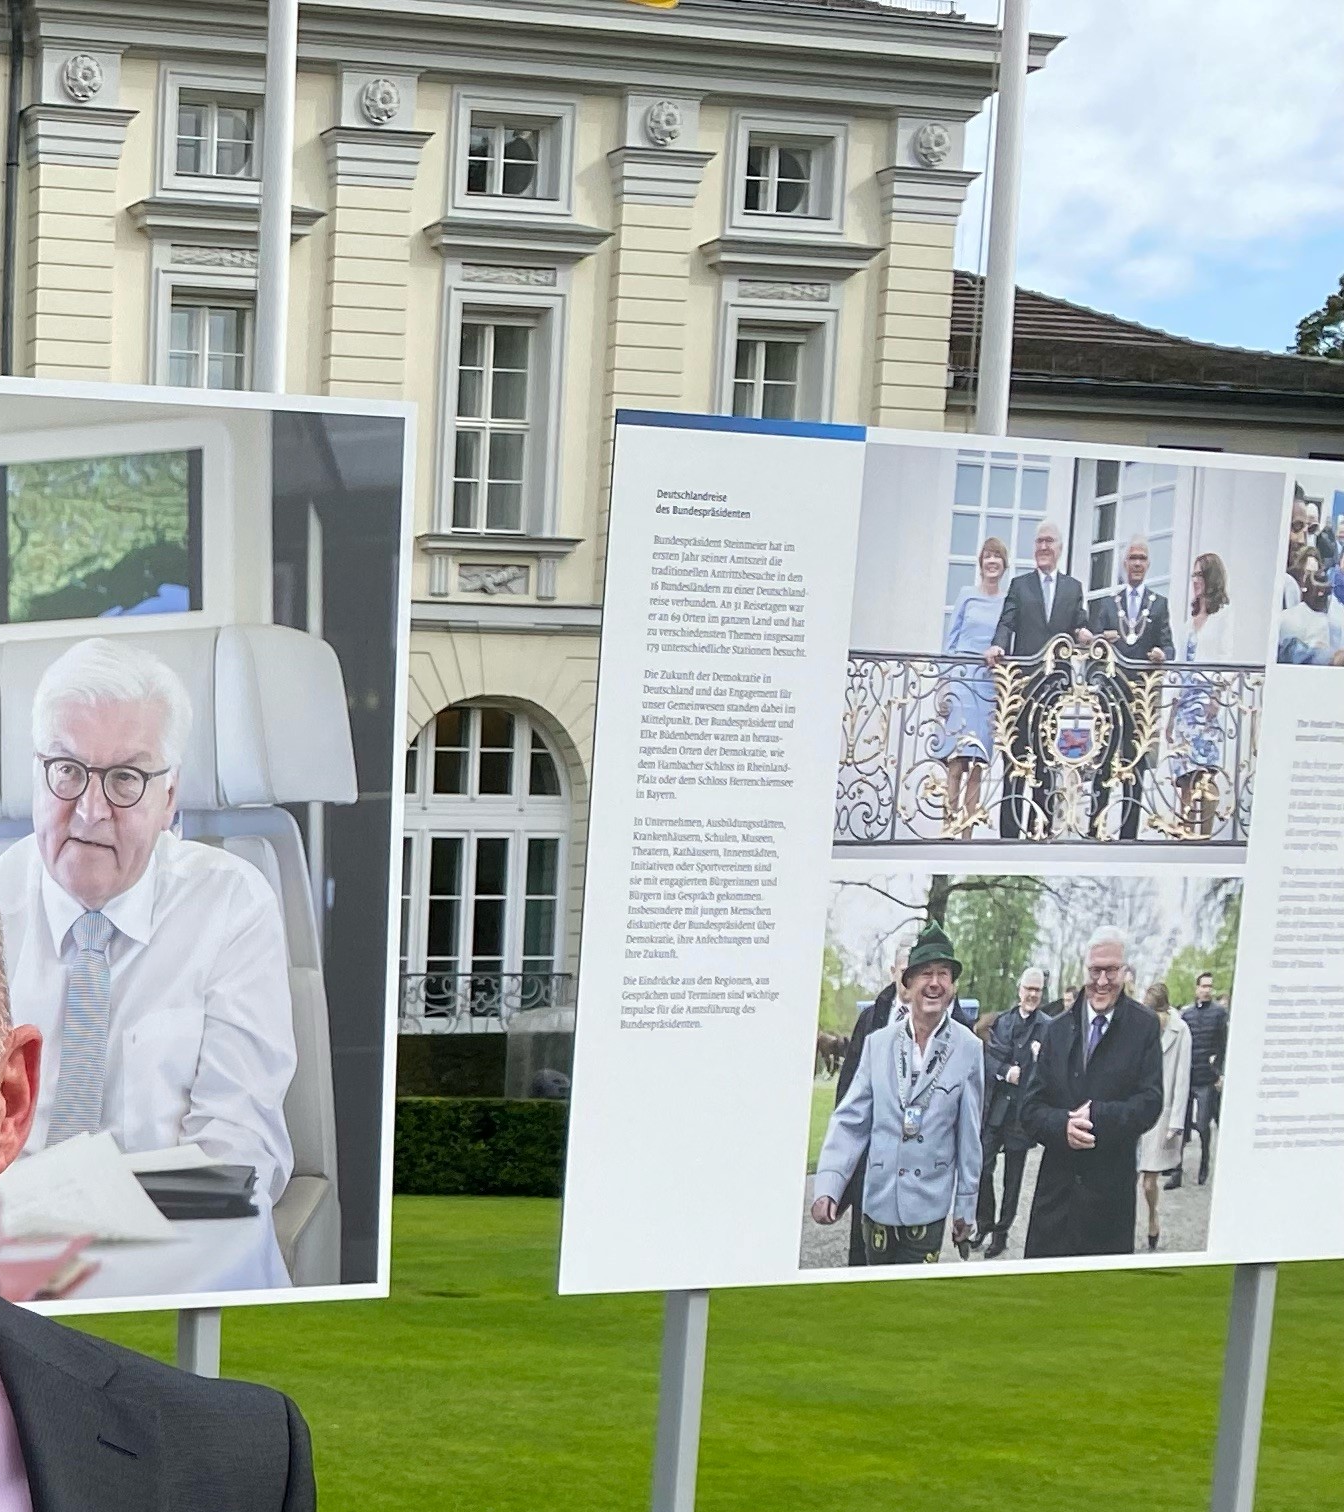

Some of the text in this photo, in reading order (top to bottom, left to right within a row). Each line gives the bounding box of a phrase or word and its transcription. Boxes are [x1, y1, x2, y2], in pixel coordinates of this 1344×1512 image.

[656, 489, 727, 502] Deutschlandreise
[656, 504, 751, 518] des Bundespräsidenten
